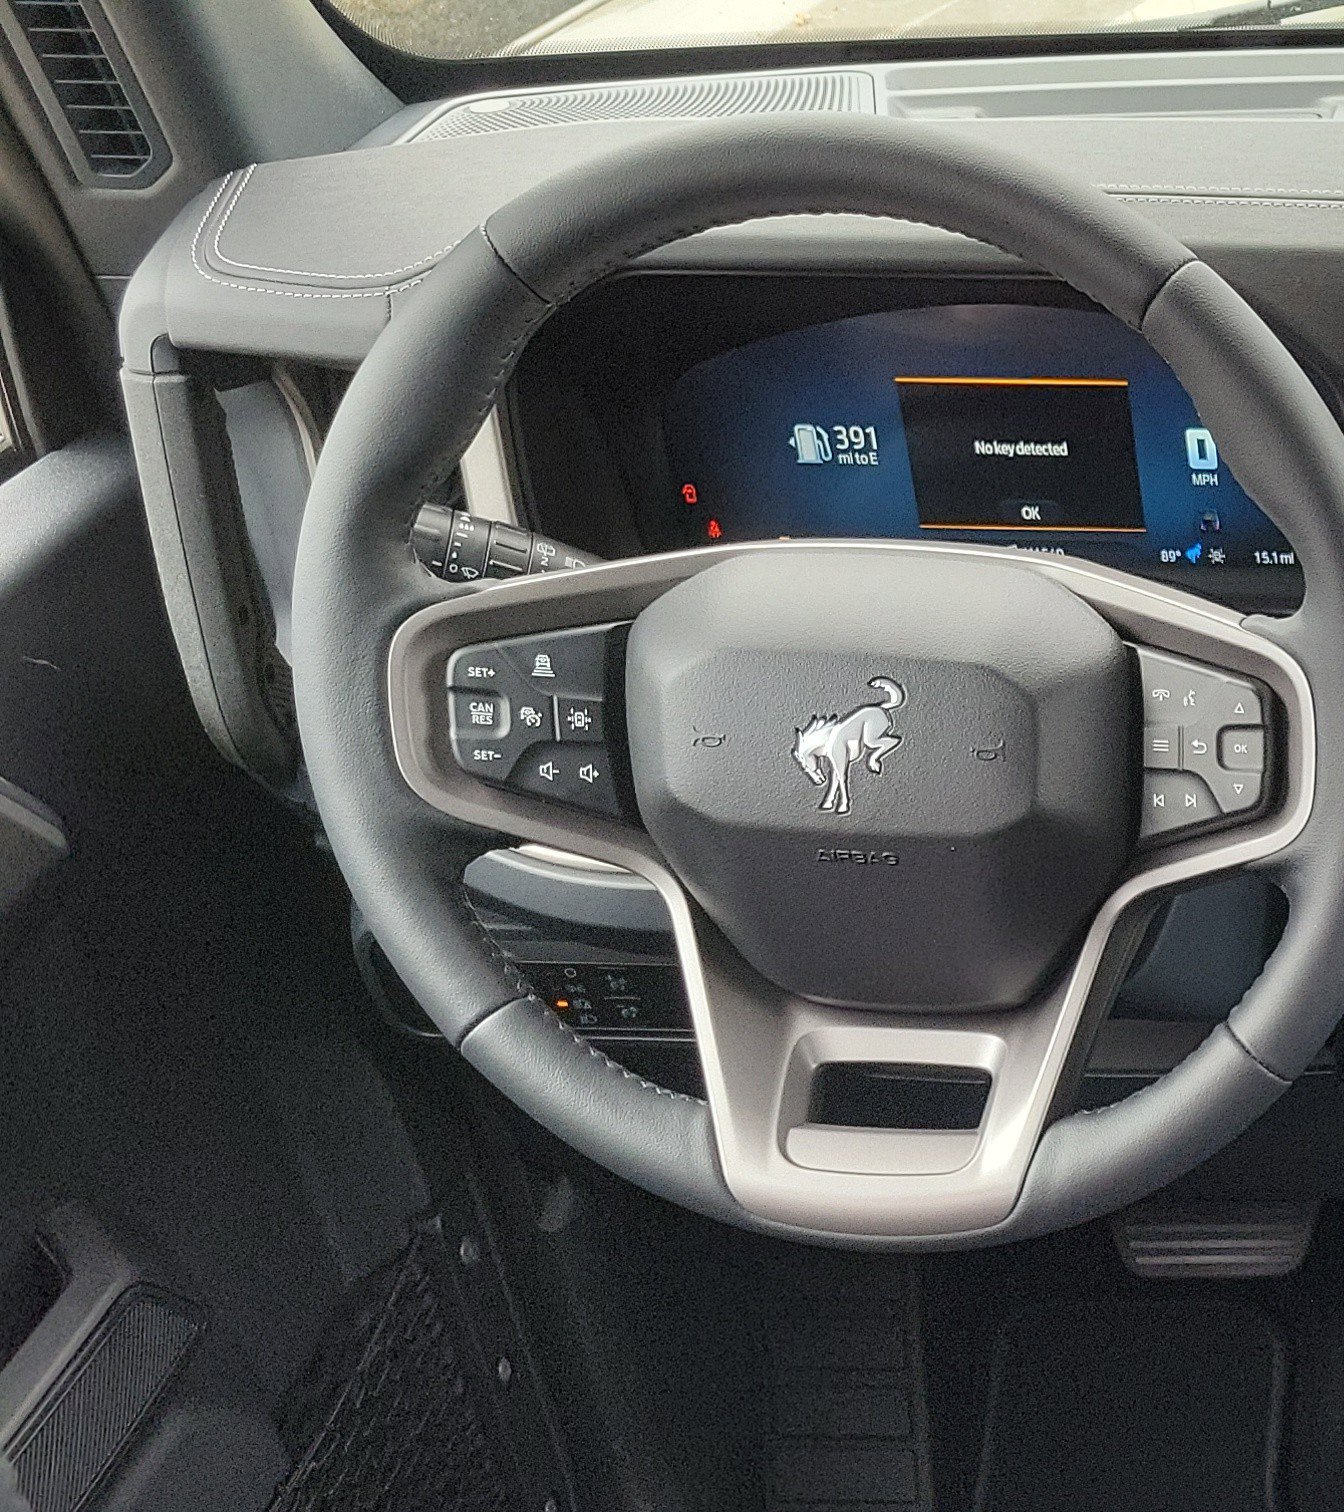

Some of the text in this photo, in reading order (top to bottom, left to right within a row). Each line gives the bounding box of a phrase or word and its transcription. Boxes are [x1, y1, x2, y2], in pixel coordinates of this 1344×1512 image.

[832, 425, 878, 450] 391
[974, 440, 1069, 458] No key detected
[855, 453, 868, 465] to
[869, 453, 879, 465] E
[1191, 473, 1219, 486] MPH
[1021, 505, 1041, 521] OK
[469, 702, 494, 712] CAN
[472, 715, 493, 725] RES
[1234, 744, 1248, 754] OK
